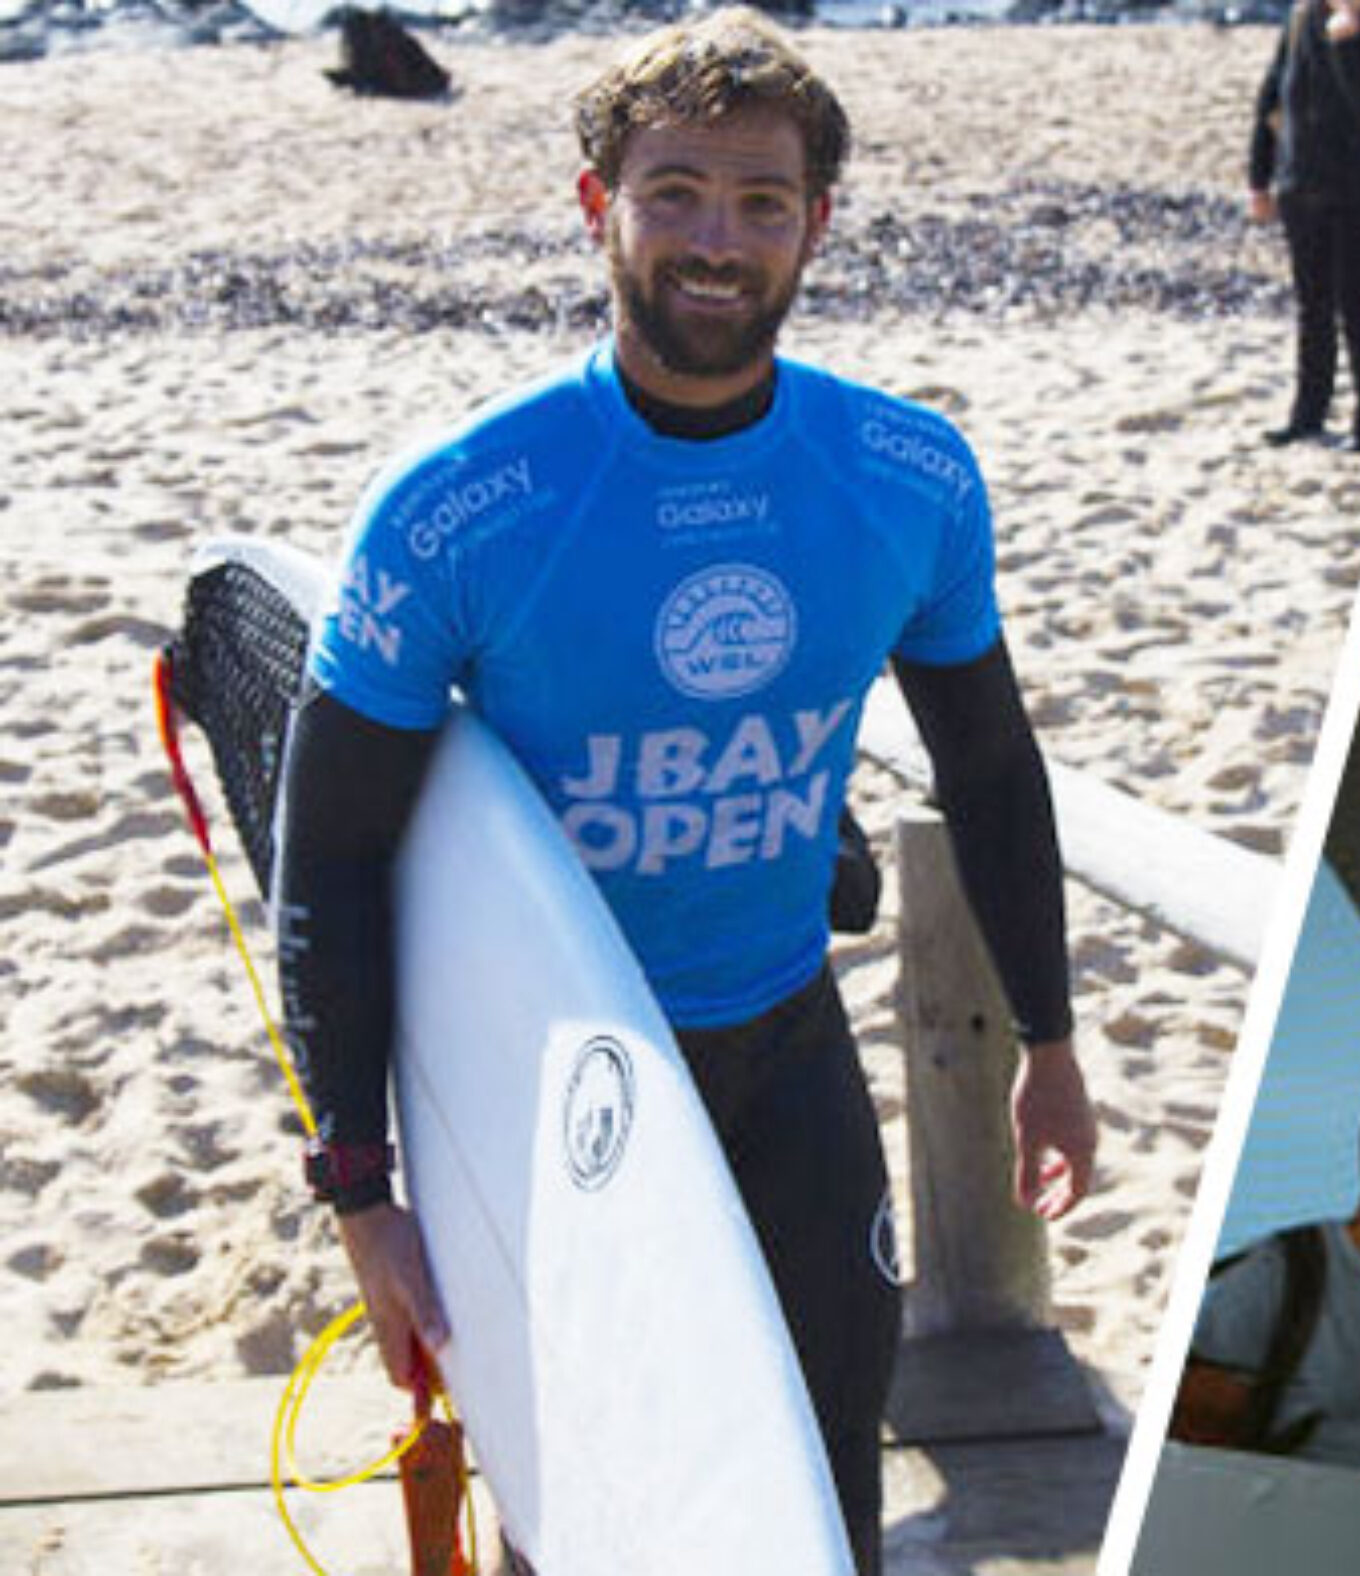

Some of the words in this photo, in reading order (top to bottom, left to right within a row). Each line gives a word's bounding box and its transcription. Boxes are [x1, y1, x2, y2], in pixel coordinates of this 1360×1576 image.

[409, 457, 532, 560] Galaxy
[656, 491, 770, 529] Galaxy
[561, 769, 830, 876] OPEN
